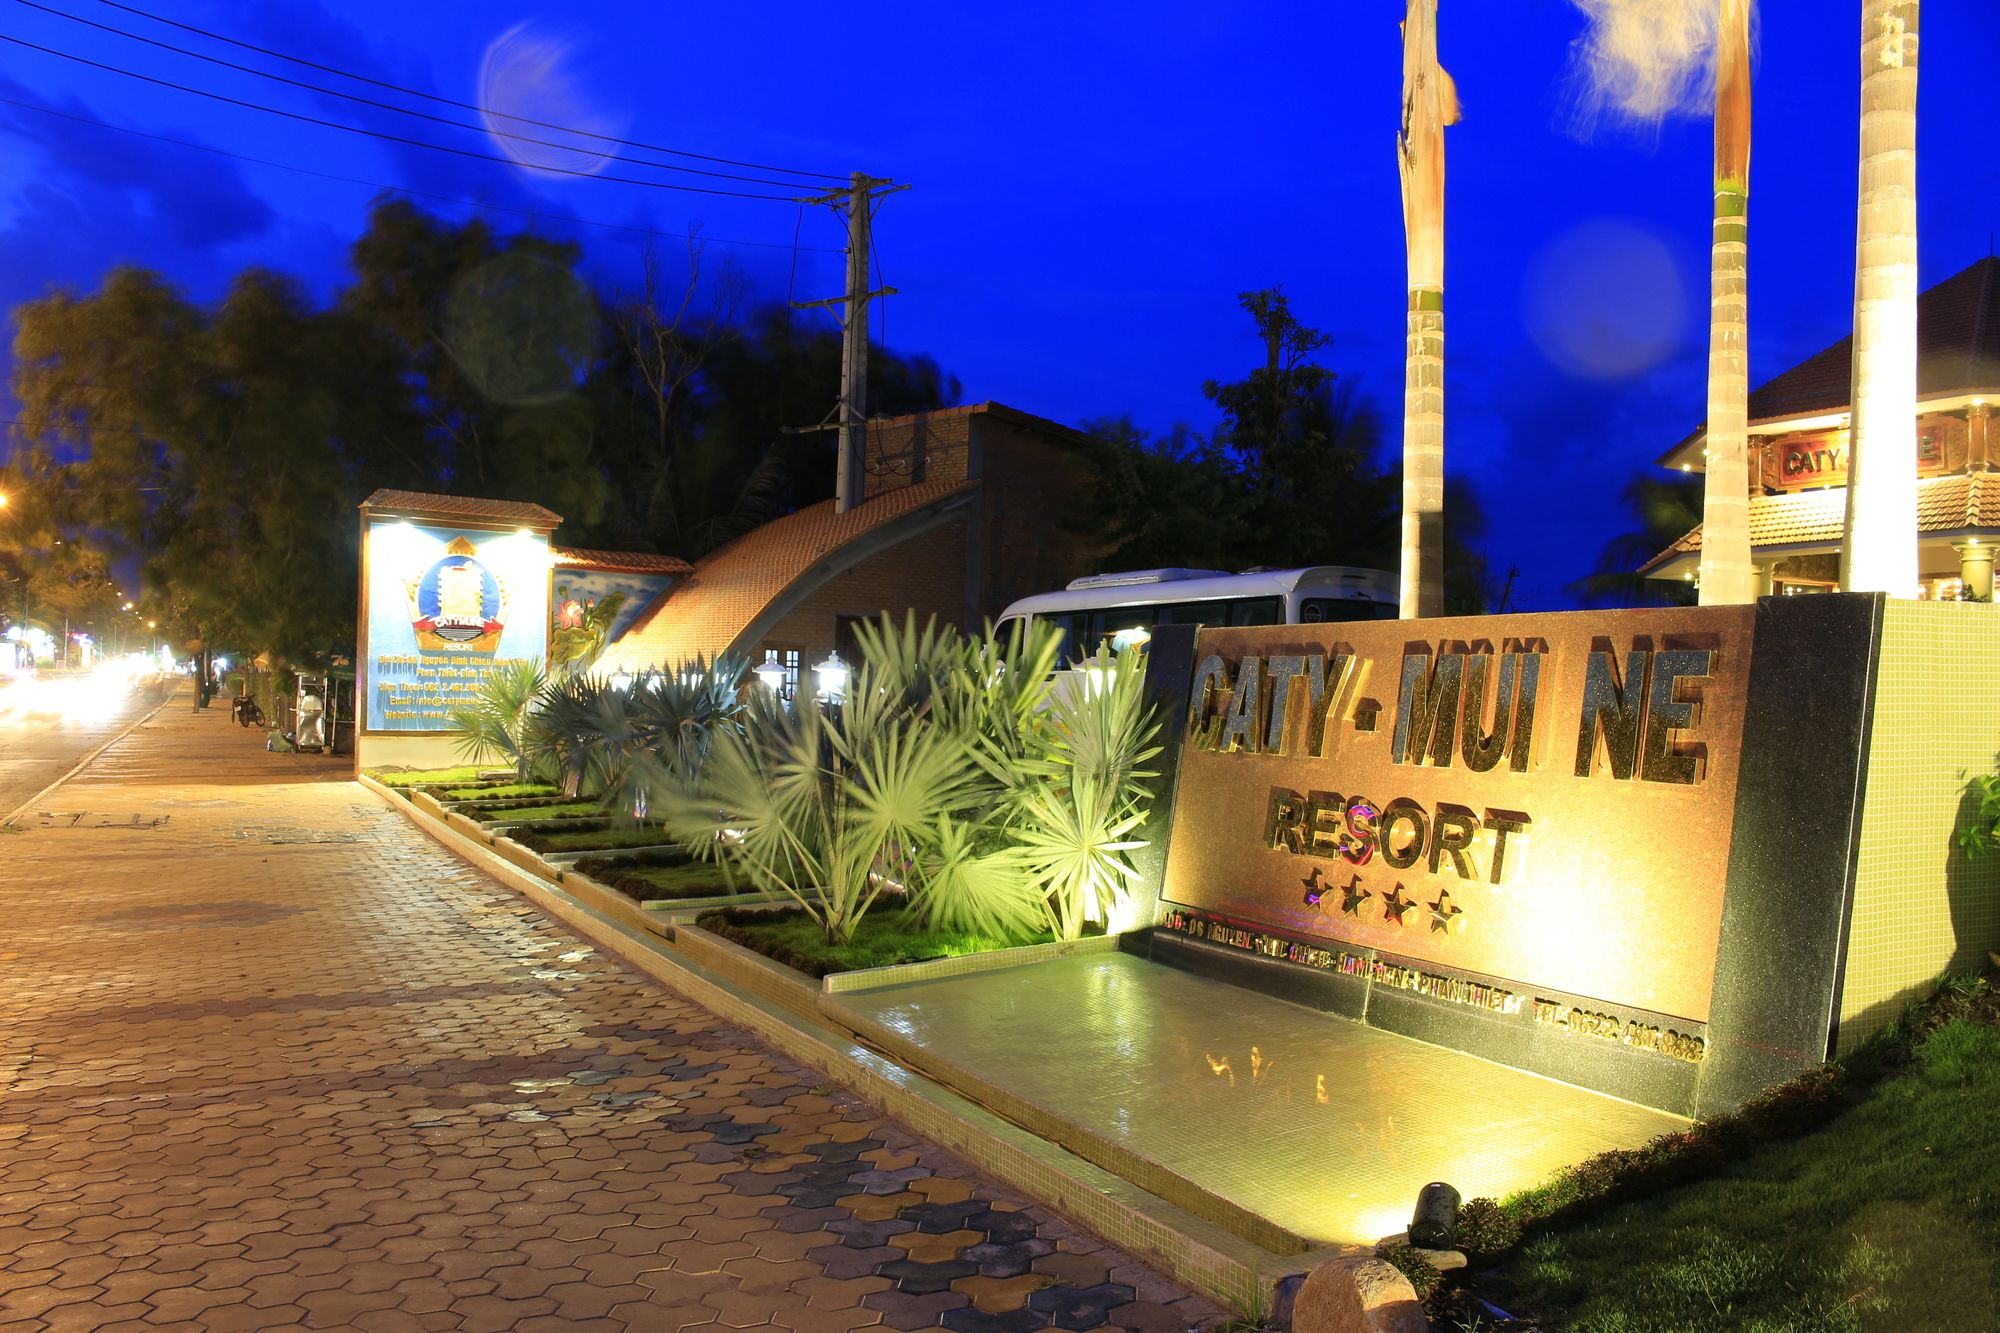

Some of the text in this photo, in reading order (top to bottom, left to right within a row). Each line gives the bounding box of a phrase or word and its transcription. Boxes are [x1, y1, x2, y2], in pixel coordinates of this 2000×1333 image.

[1787, 448, 1841, 476] CATY
[443, 643, 473, 651] RESORT
[1392, 653, 1549, 774] MUI
[1574, 650, 1716, 786] NE
[1267, 797, 1528, 885] RESORT
